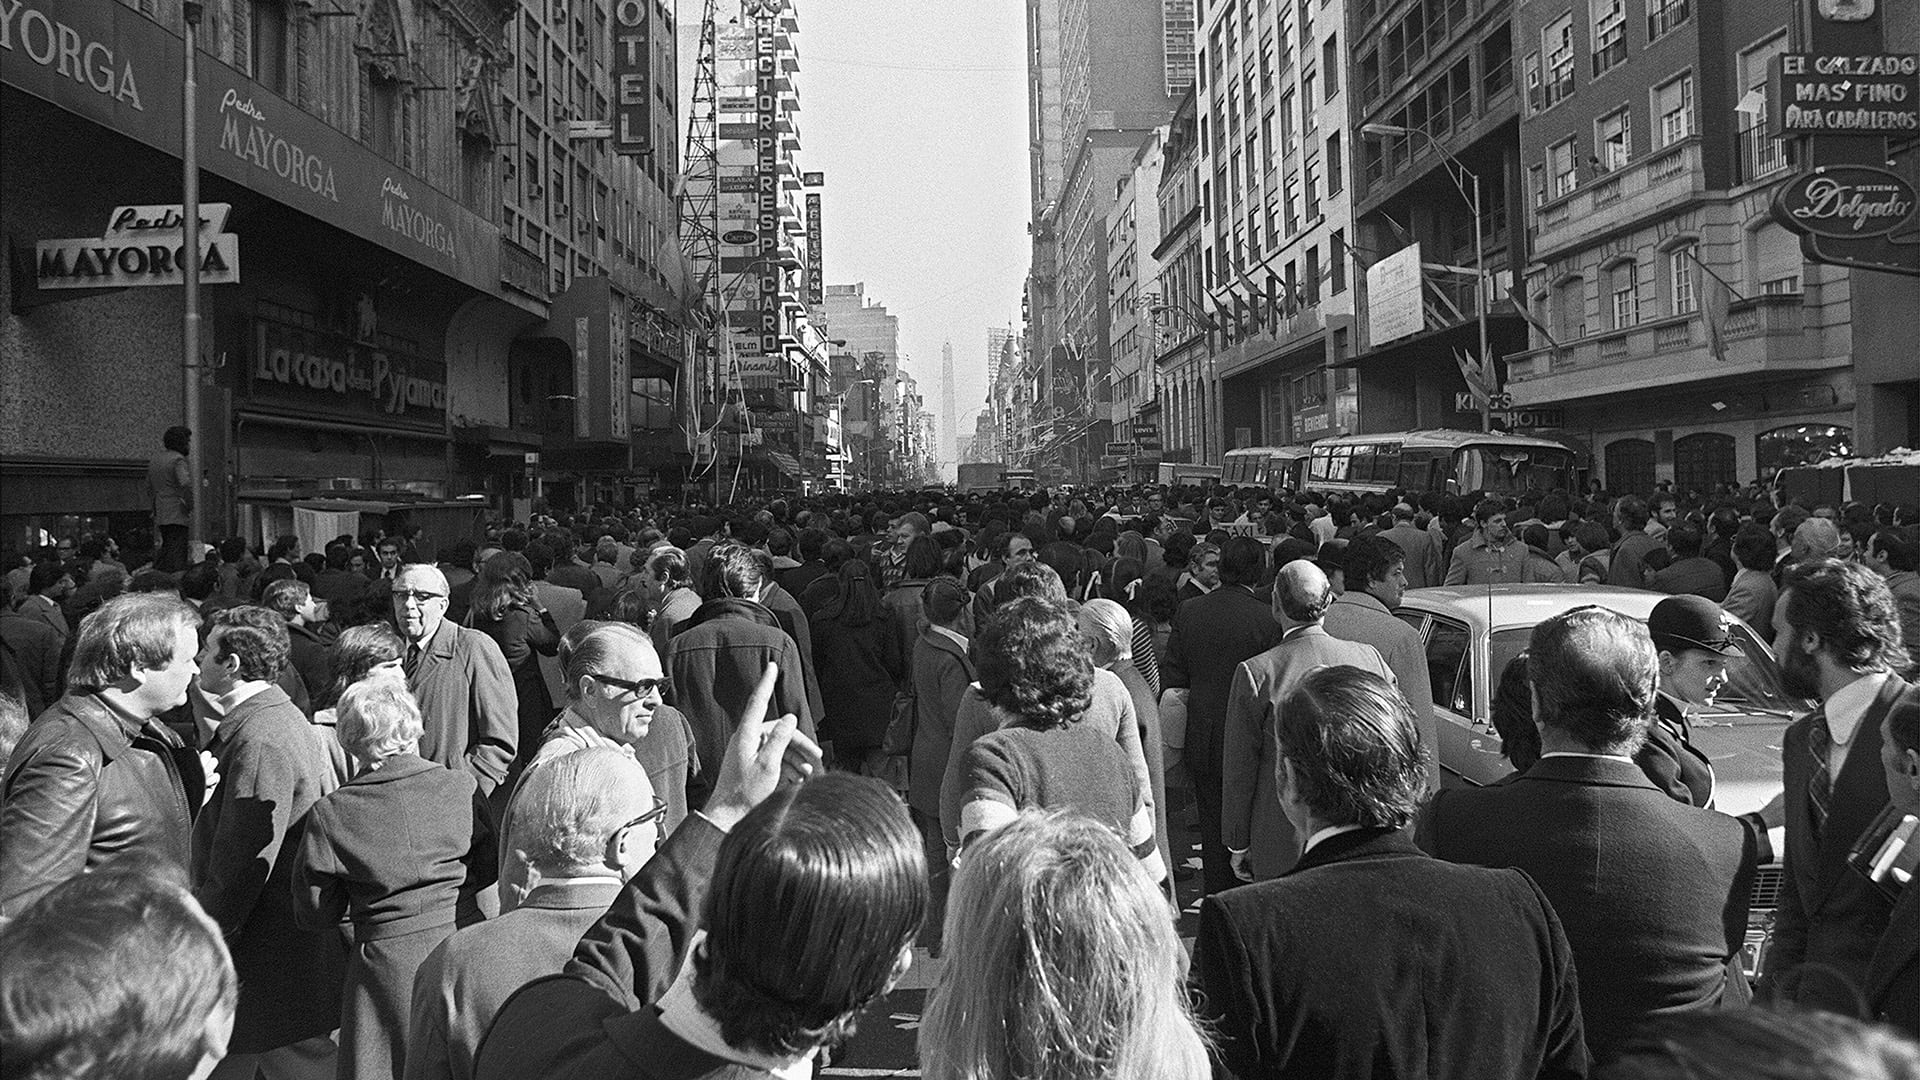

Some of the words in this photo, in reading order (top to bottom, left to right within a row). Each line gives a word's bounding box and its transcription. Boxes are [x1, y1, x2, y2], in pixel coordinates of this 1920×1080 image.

[617, 0, 646, 144] OTEL
[758, 18, 773, 130] HECTOR
[1784, 56, 1805, 75] EL
[1815, 55, 1916, 75] CALZADO
[220, 88, 265, 121] Pedro
[1796, 82, 1845, 102] MAS
[1855, 83, 1907, 102] FINO
[1785, 103, 1823, 128] PARA
[1825, 108, 1917, 129] CABALLEROS
[219, 113, 338, 203] MAYORGA
[112, 208, 211, 231] Pedr
[1793, 178, 1911, 231] Delgado
[382, 197, 456, 260] MAYORGA
[256, 324, 290, 384] La
[291, 353, 347, 394] casa
[1456, 391, 1512, 412] KIG'S
